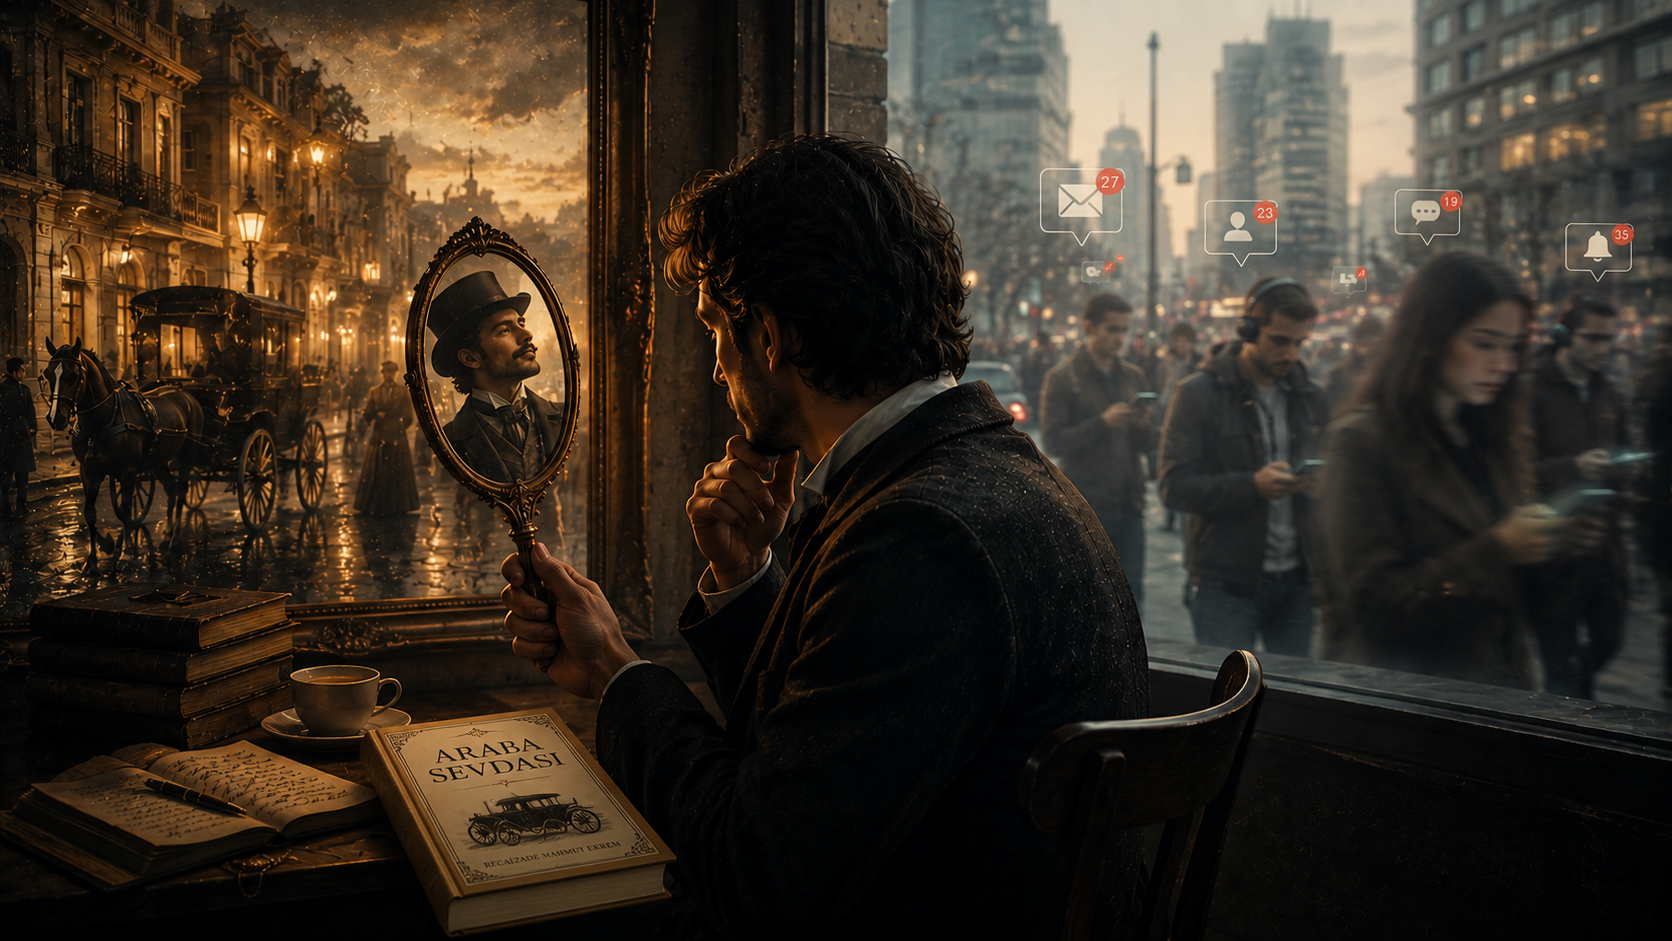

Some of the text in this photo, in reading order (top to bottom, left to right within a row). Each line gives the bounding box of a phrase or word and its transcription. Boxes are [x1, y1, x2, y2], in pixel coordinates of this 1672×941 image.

[435, 737, 545, 764] ARABA
[428, 751, 567, 784] SEVDASI
[542, 847, 585, 860] MAHMUT
[587, 841, 622, 853] EKREM
